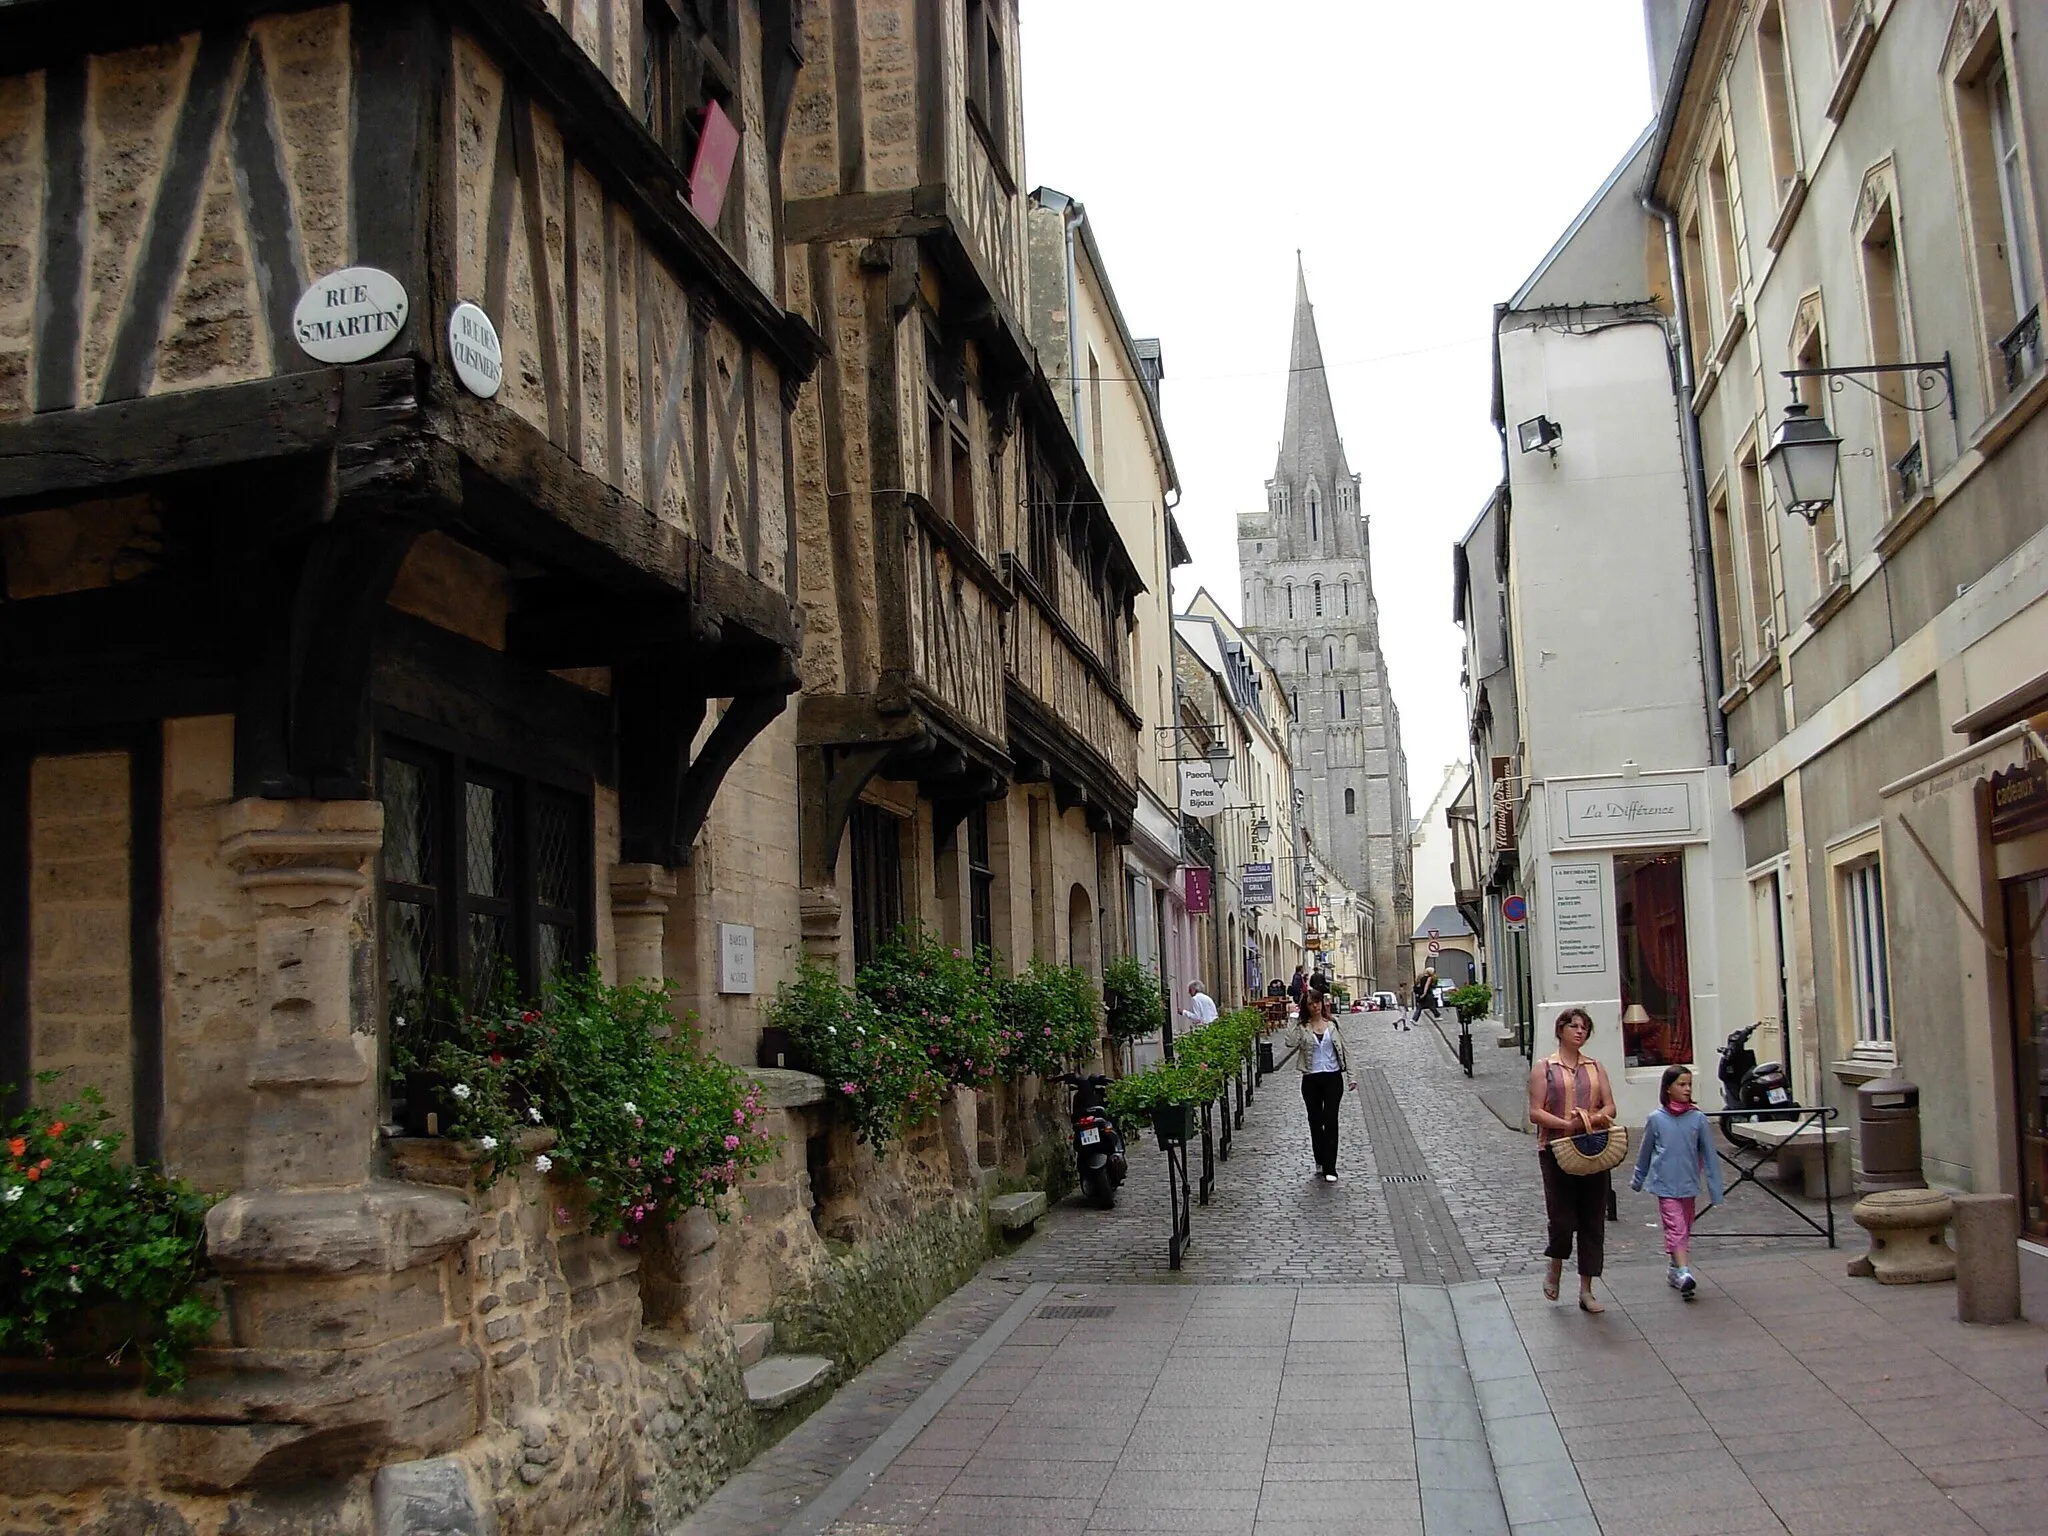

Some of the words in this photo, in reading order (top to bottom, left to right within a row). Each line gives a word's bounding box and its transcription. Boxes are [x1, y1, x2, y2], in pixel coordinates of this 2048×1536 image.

[326, 284, 368, 308] RUE
[462, 315, 480, 343] RUE
[480, 325, 497, 353] DES
[455, 341, 500, 383] CUISINIERS
[1190, 789, 1214, 797] Perles
[1190, 799, 1215, 808] Bijoux
[1581, 804, 1602, 819] La
[1607, 800, 1675, 821] Différence
[1250, 802, 1260, 865] PIZZERI
